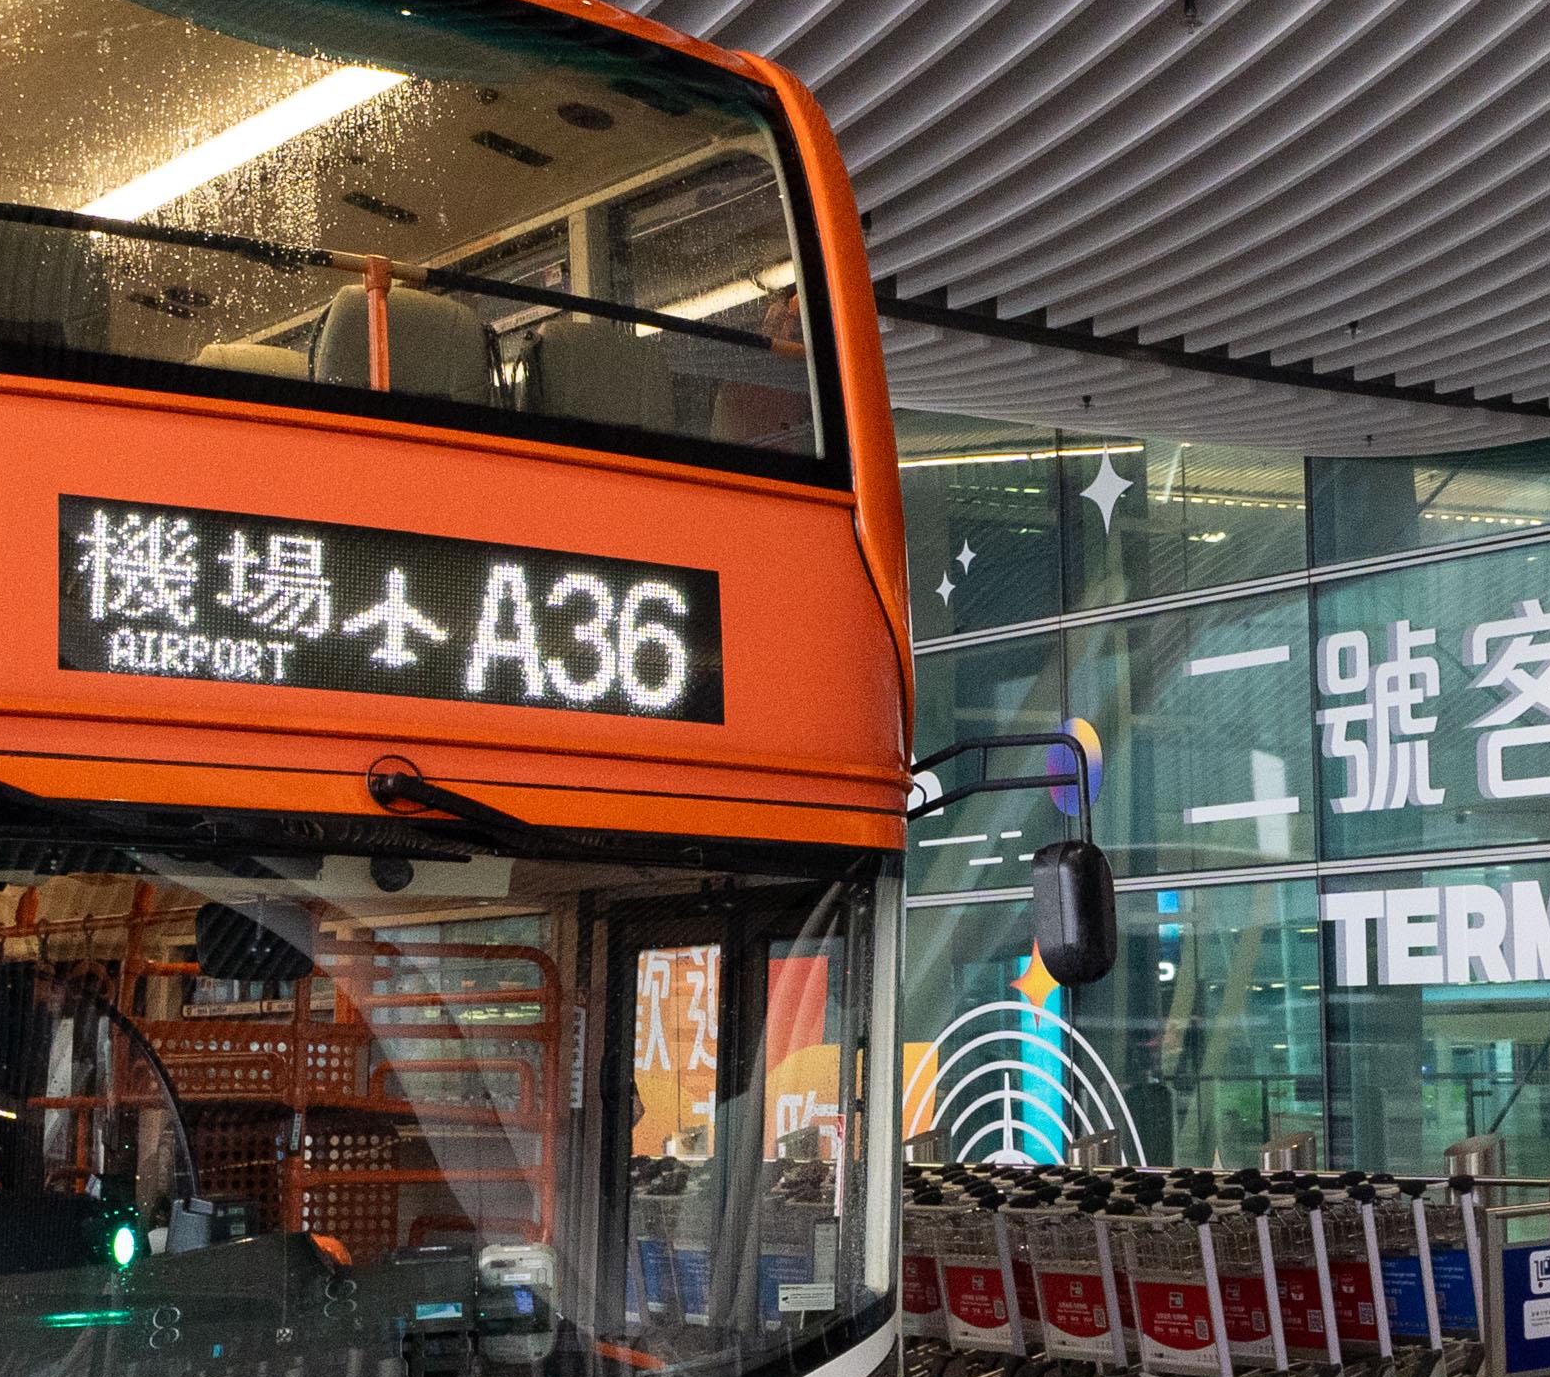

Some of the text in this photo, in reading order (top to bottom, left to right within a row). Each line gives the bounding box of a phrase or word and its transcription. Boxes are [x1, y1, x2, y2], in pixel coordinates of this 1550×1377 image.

[75, 508, 689, 713] 機場 A36
[107, 630, 296, 682] AIRPORT
